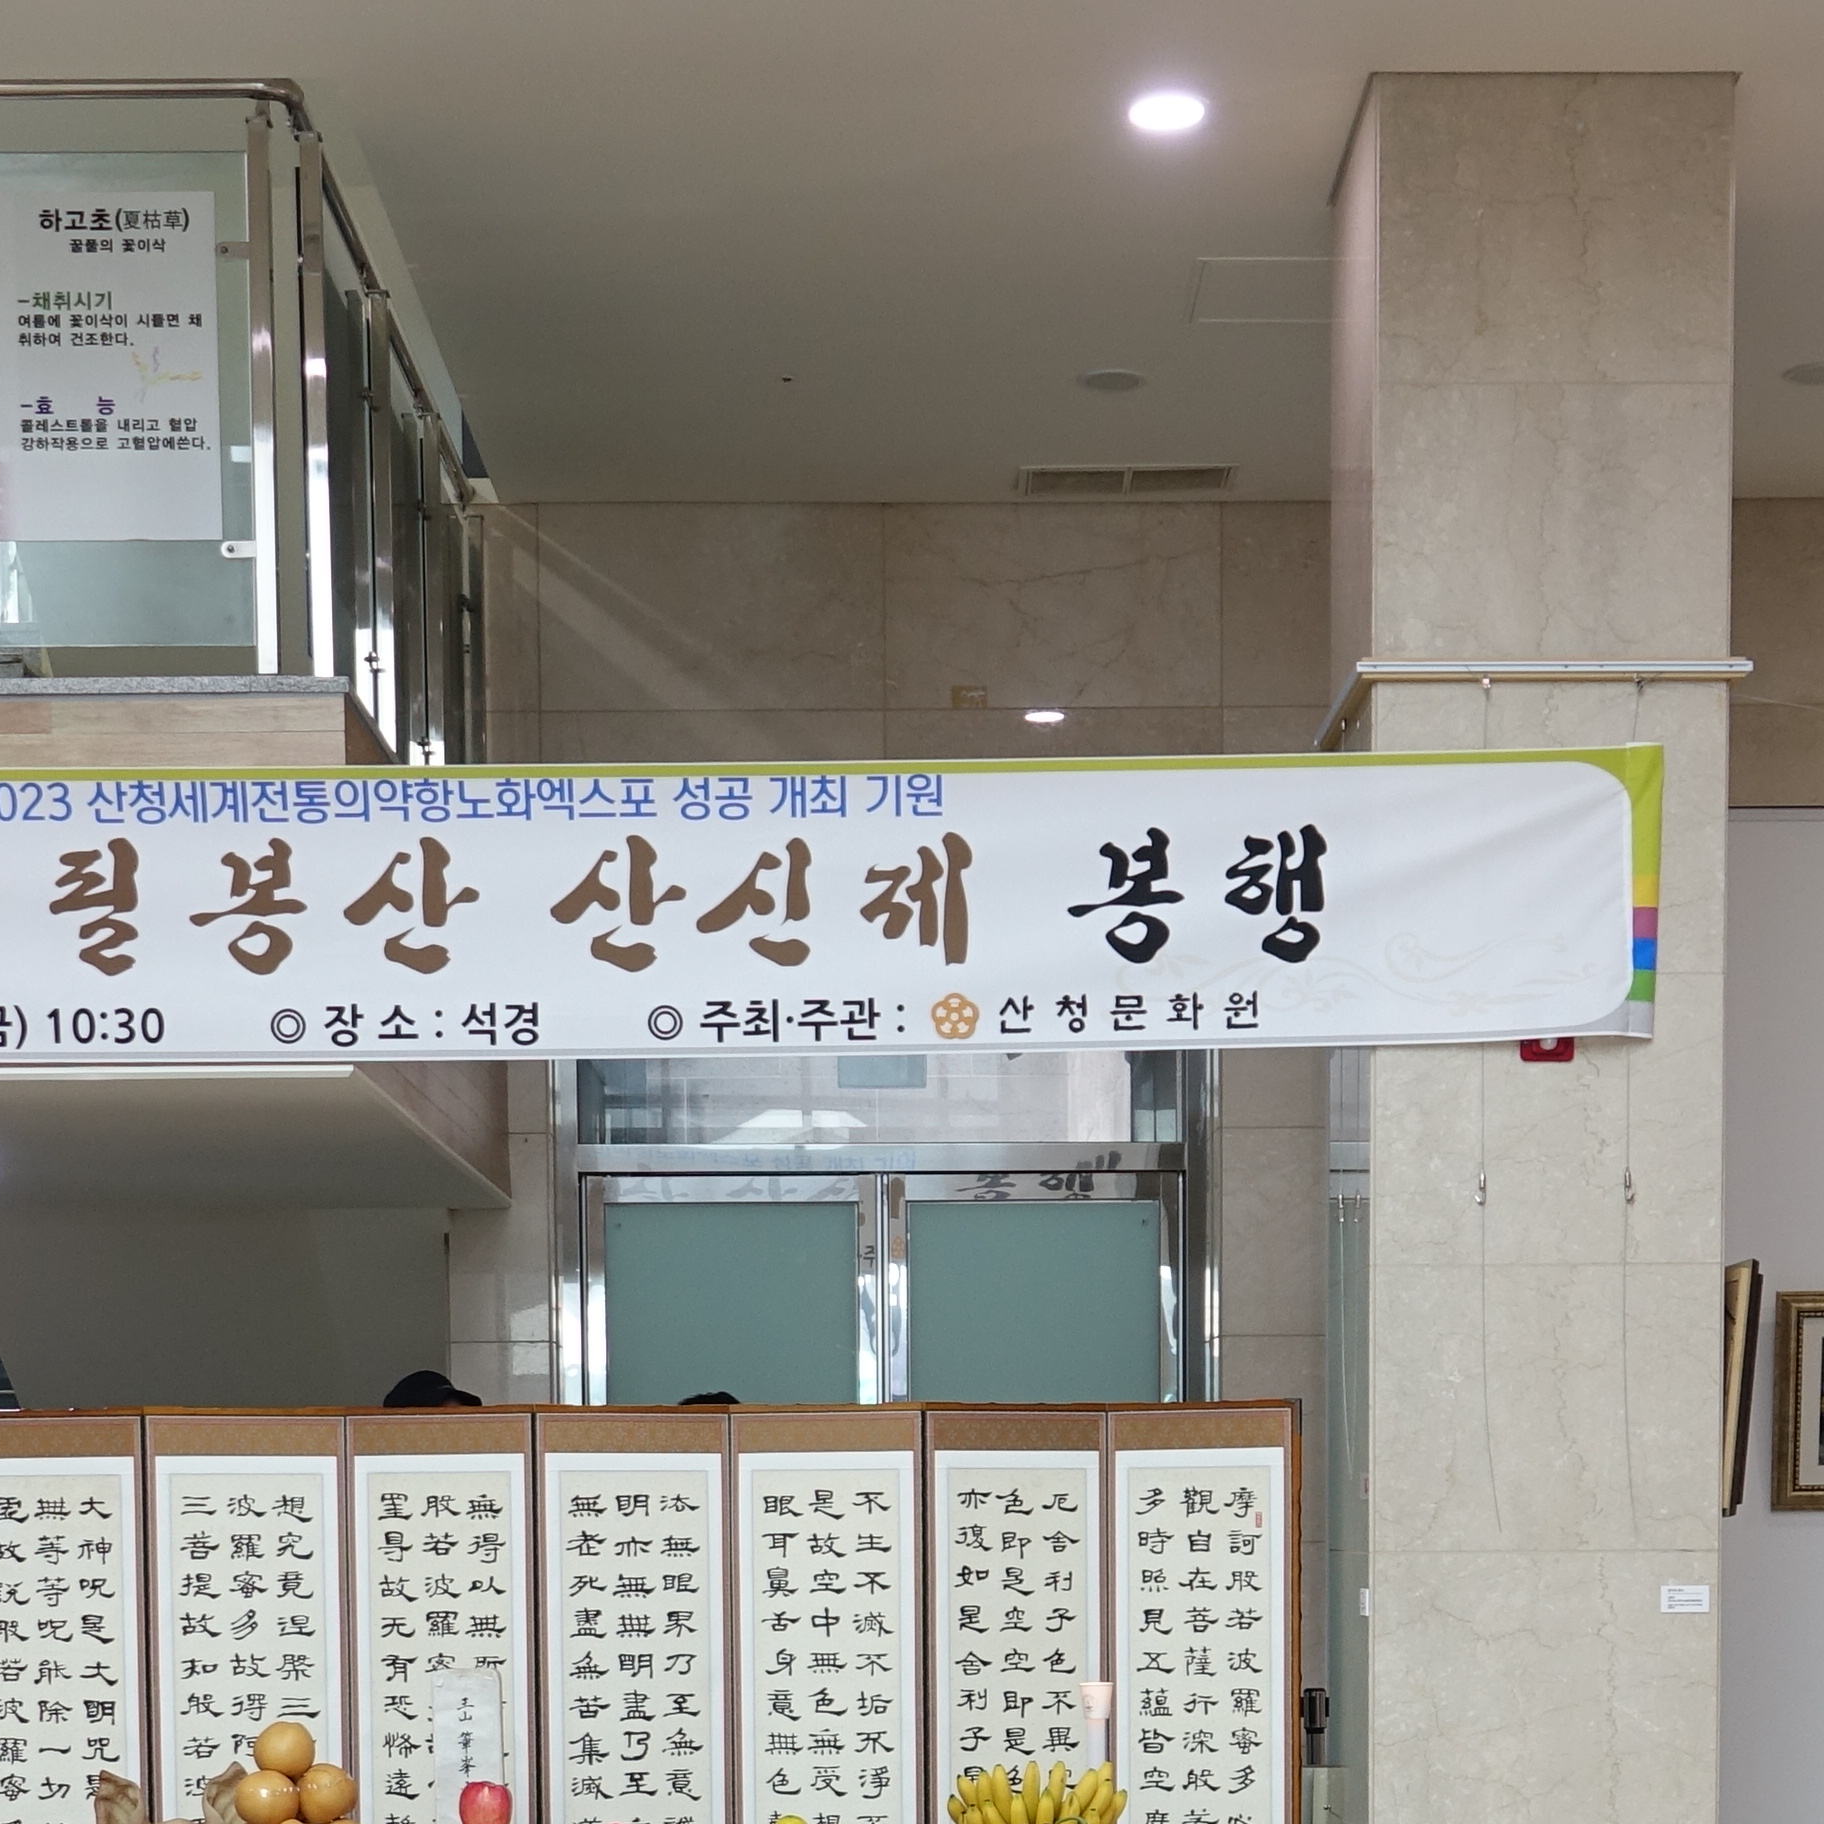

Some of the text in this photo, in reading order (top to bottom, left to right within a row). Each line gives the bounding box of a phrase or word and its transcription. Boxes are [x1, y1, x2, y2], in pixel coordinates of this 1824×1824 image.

[39, 208, 189, 232] 하고초(夏枯草)
[118, 418, 159, 432] 내리고
[87, 777, 657, 824] 산청세계전통의약항노화엑스포
[673, 776, 752, 820] 성공
[770, 775, 846, 818] 개최
[866, 773, 942, 817] 기원
[49, 836, 479, 975] 필봉산
[550, 833, 972, 974] 산신제
[1067, 824, 1327, 964] 봉행
[47, 1008, 164, 1044] 10:30
[461, 1002, 539, 1045] 석경
